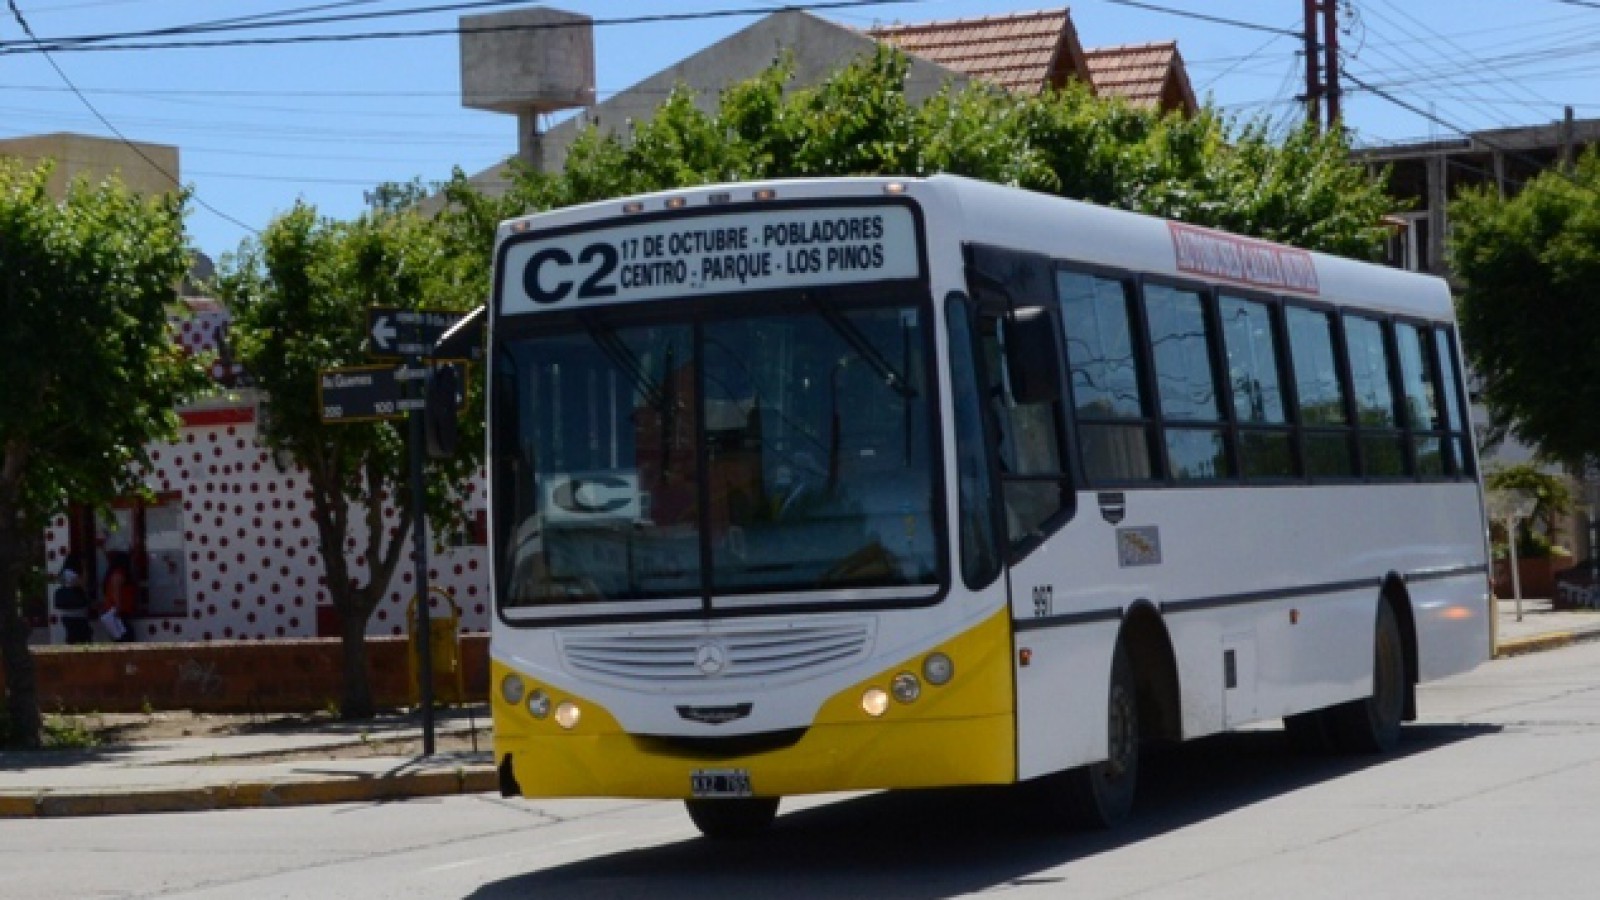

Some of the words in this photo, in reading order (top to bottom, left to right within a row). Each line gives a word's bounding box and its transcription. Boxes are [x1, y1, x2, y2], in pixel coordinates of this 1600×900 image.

[621, 238, 638, 260] 17
[643, 234, 664, 258] DE
[668, 227, 748, 255] OCTUBRE
[764, 215, 884, 247] POBLADORES
[523, 242, 618, 304] C2
[620, 258, 687, 289] CENTRO
[702, 252, 771, 284] PARQUE
[786, 248, 823, 274] LOS
[827, 243, 884, 271] PINOS
[553, 476, 632, 513] C
